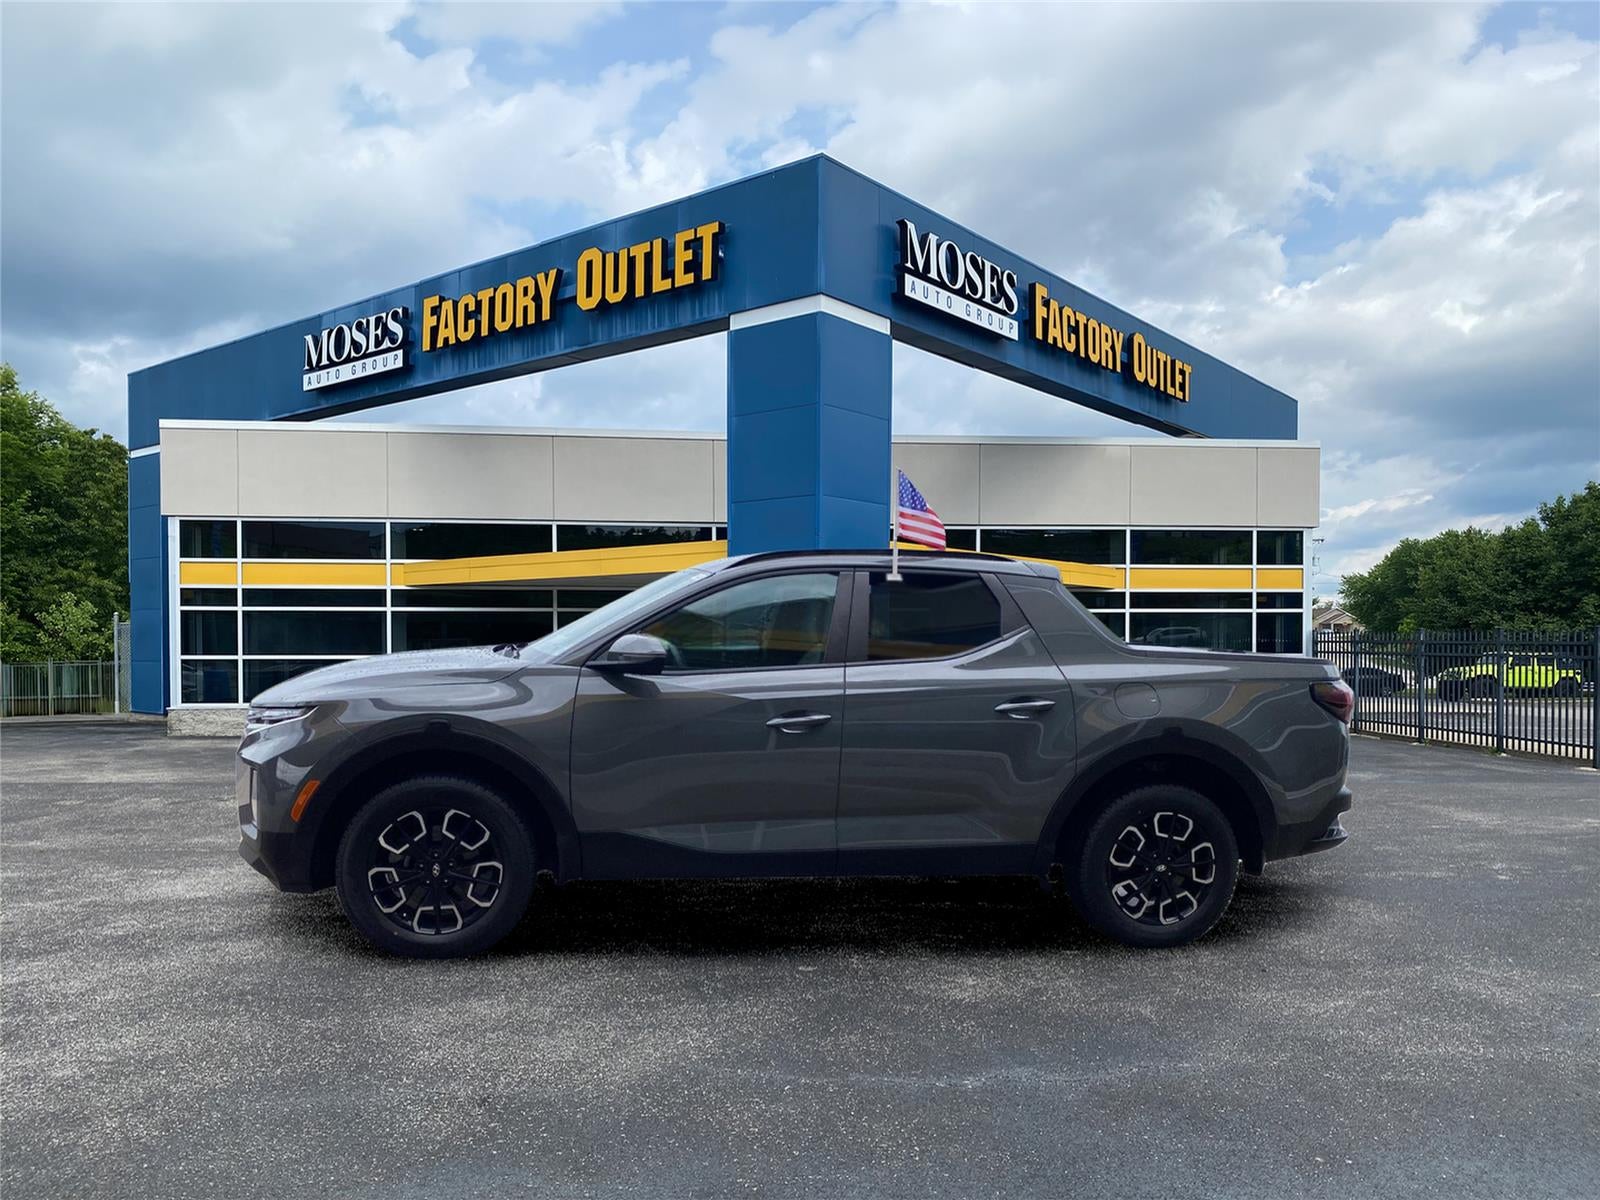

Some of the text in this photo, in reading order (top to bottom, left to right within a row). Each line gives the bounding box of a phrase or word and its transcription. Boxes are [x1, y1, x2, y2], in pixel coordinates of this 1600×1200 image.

[422, 221, 720, 352] FACTORY OUTLET
[904, 218, 1018, 315] MOSES
[303, 307, 404, 370] MOSES
[909, 280, 1015, 335] AUTO GROUP
[1034, 282, 1192, 402] FACTORY OUTLET
[306, 353, 400, 388] AUTO GROUP
